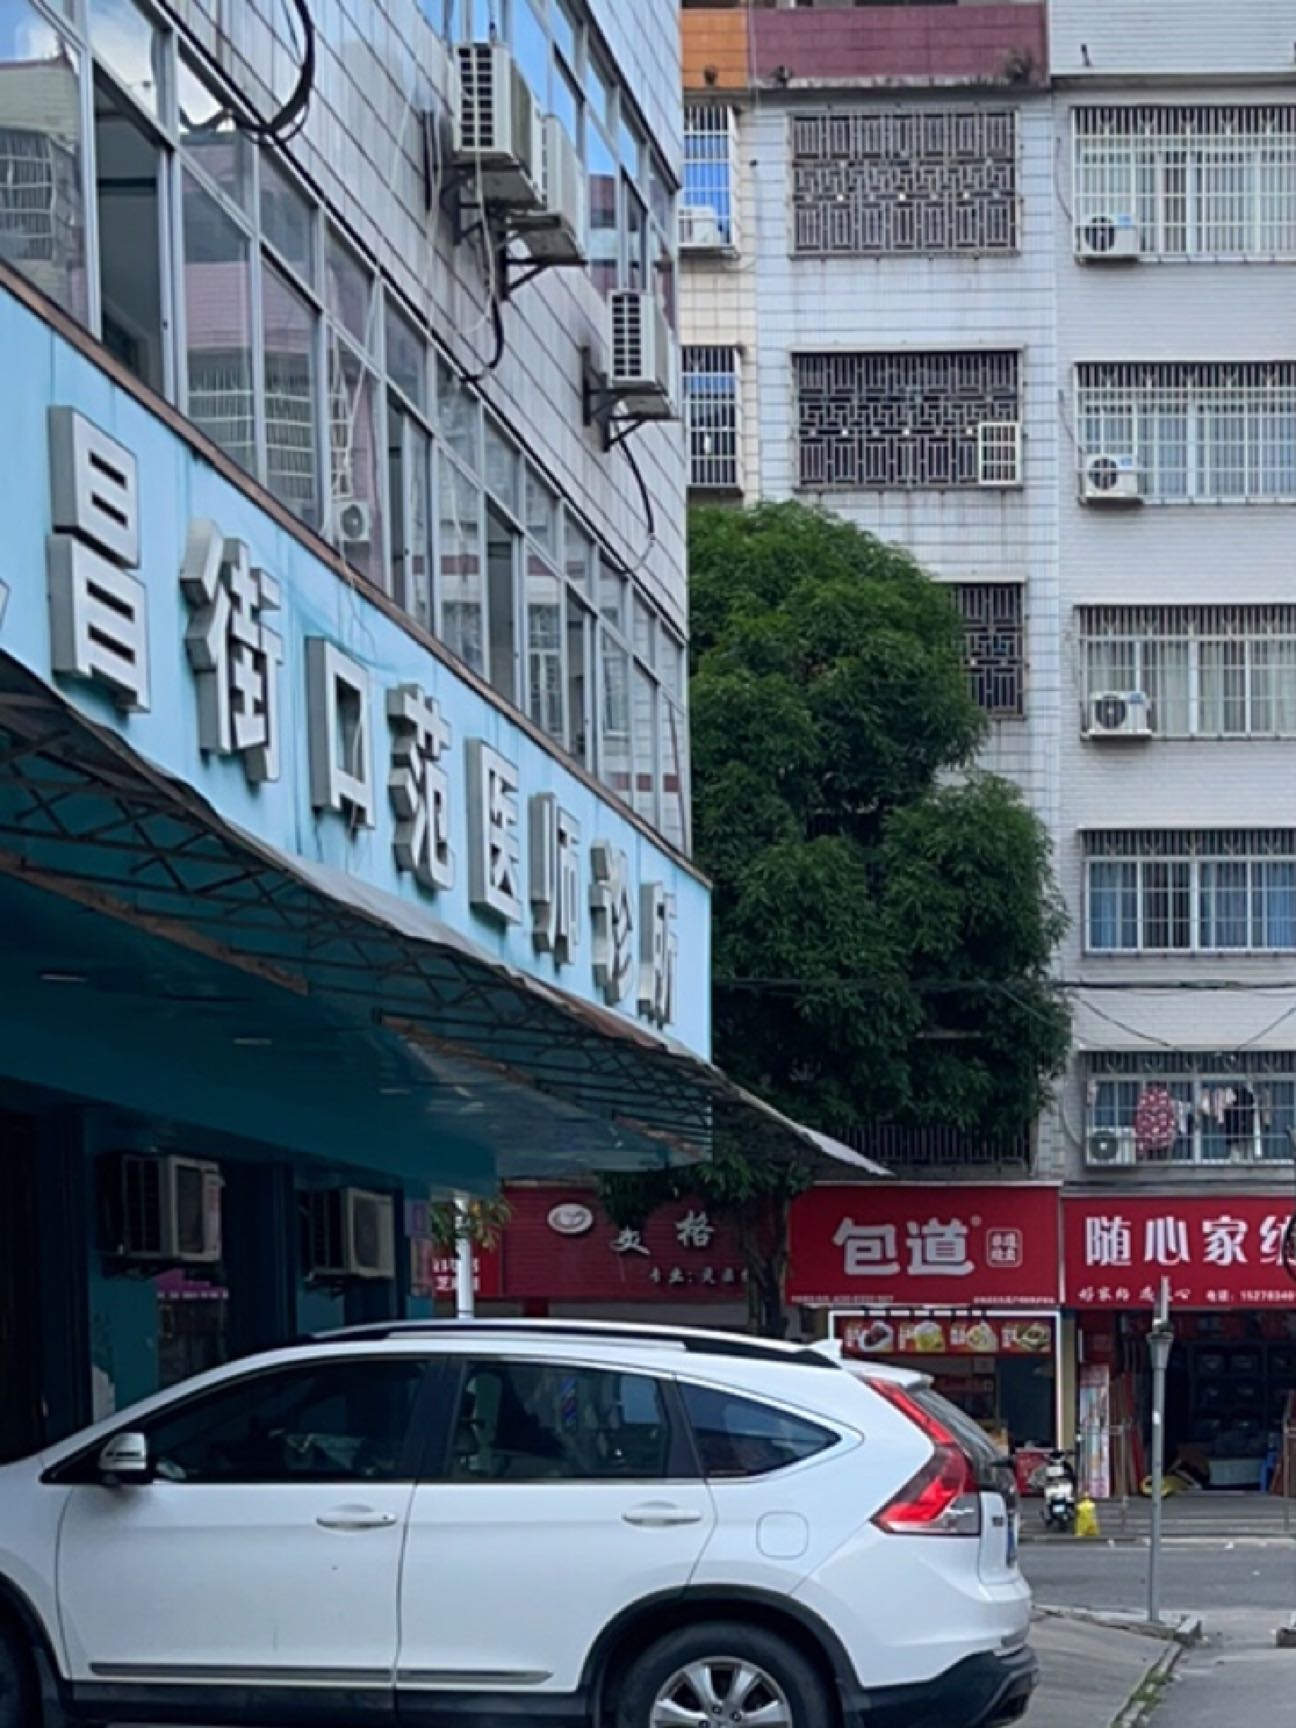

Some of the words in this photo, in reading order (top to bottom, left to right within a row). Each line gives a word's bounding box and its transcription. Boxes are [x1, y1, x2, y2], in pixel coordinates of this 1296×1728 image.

[0, 405, 678, 1027] 昌街口范医师诊所
[833, 1217, 975, 1275] 包道
